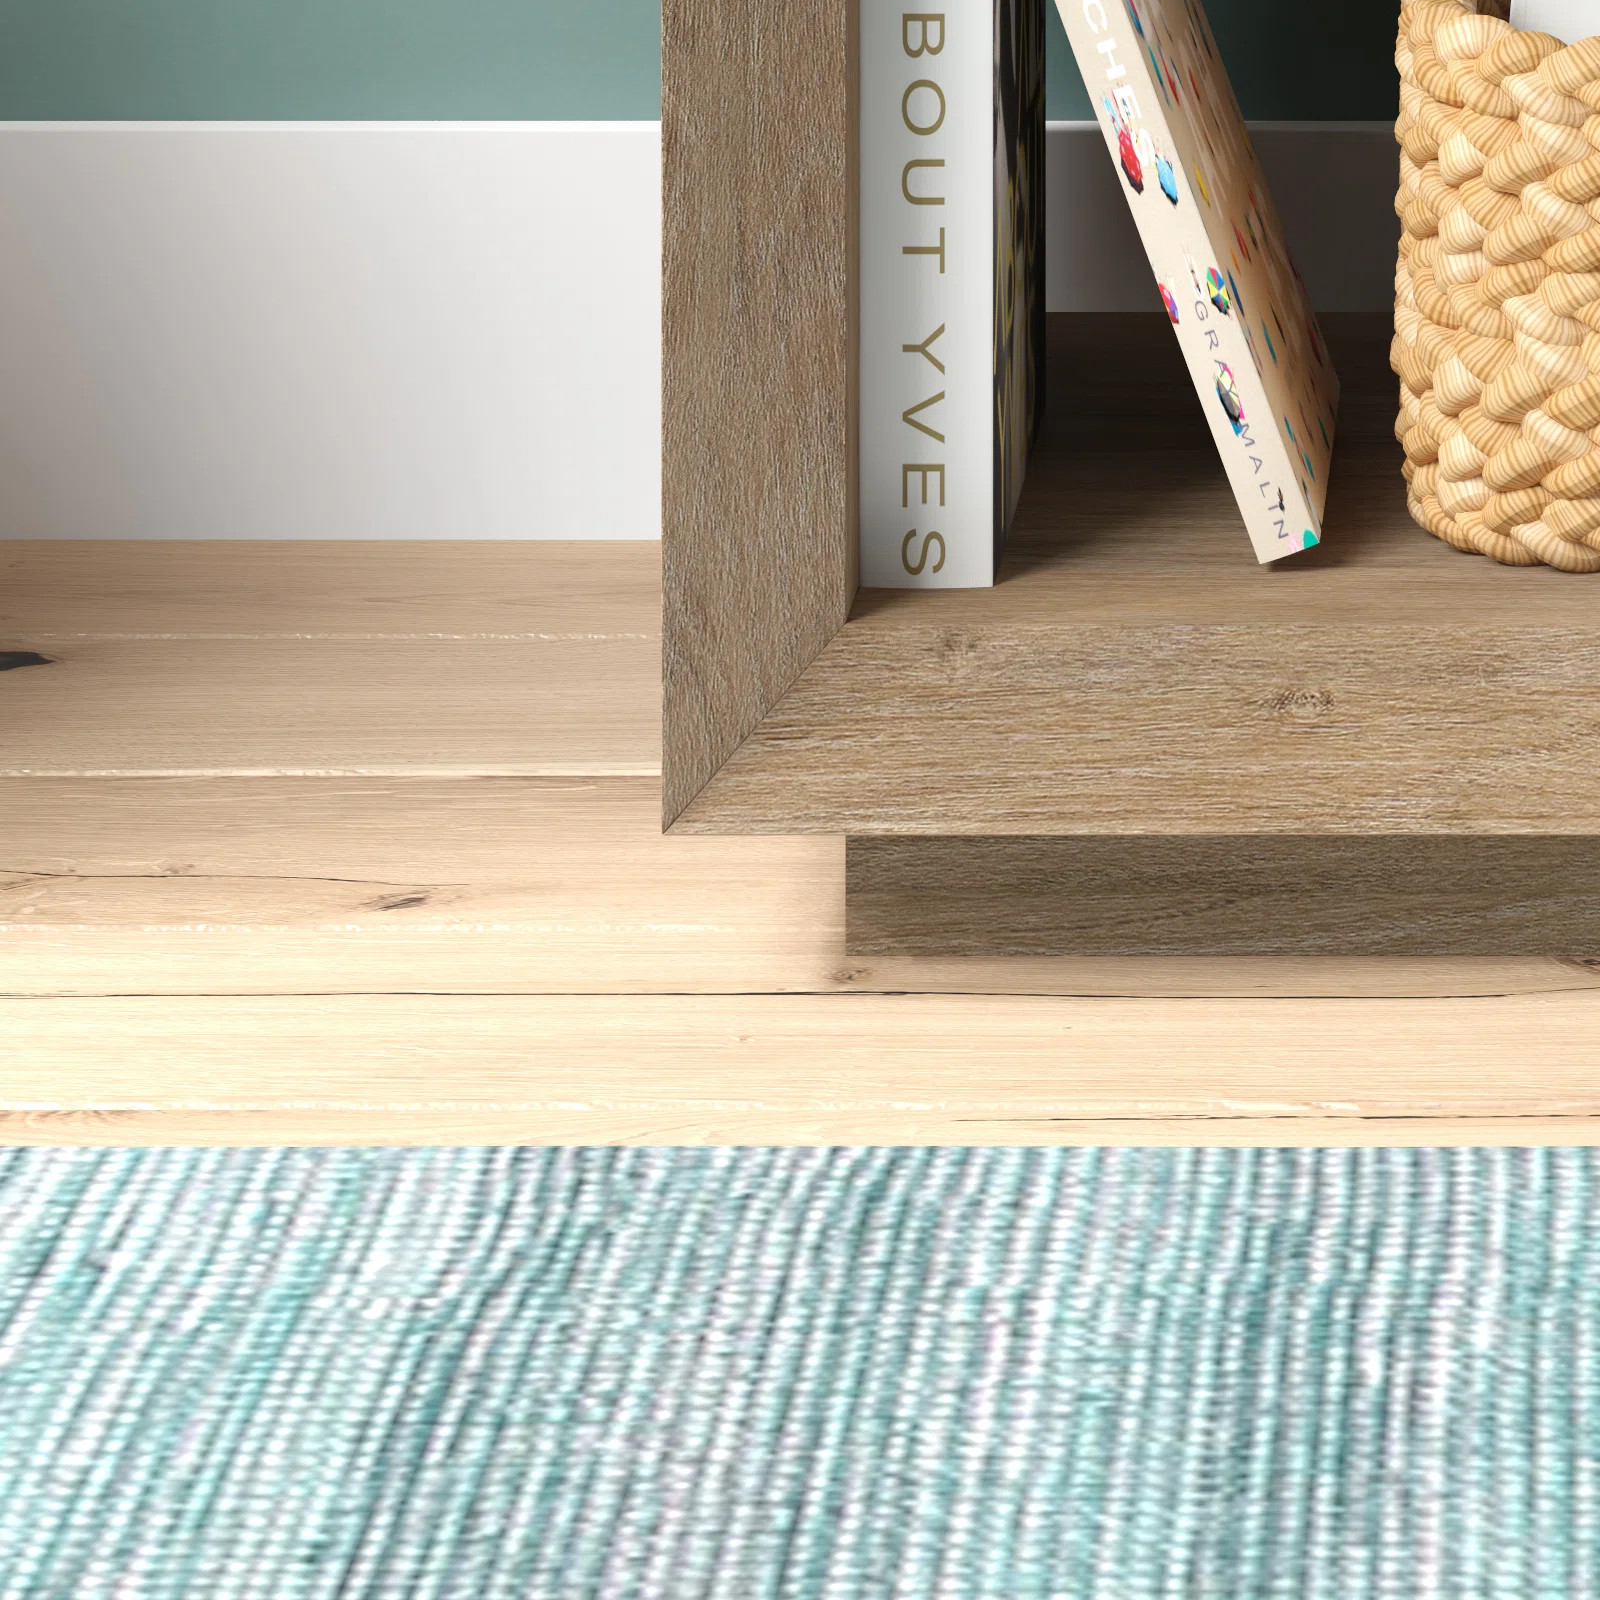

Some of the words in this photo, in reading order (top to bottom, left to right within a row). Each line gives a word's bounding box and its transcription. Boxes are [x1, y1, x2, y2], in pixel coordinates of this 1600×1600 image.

[902, 322, 947, 576] YVES
[1195, 299, 1238, 400] GRAY
[1239, 422, 1289, 540] MALIN
